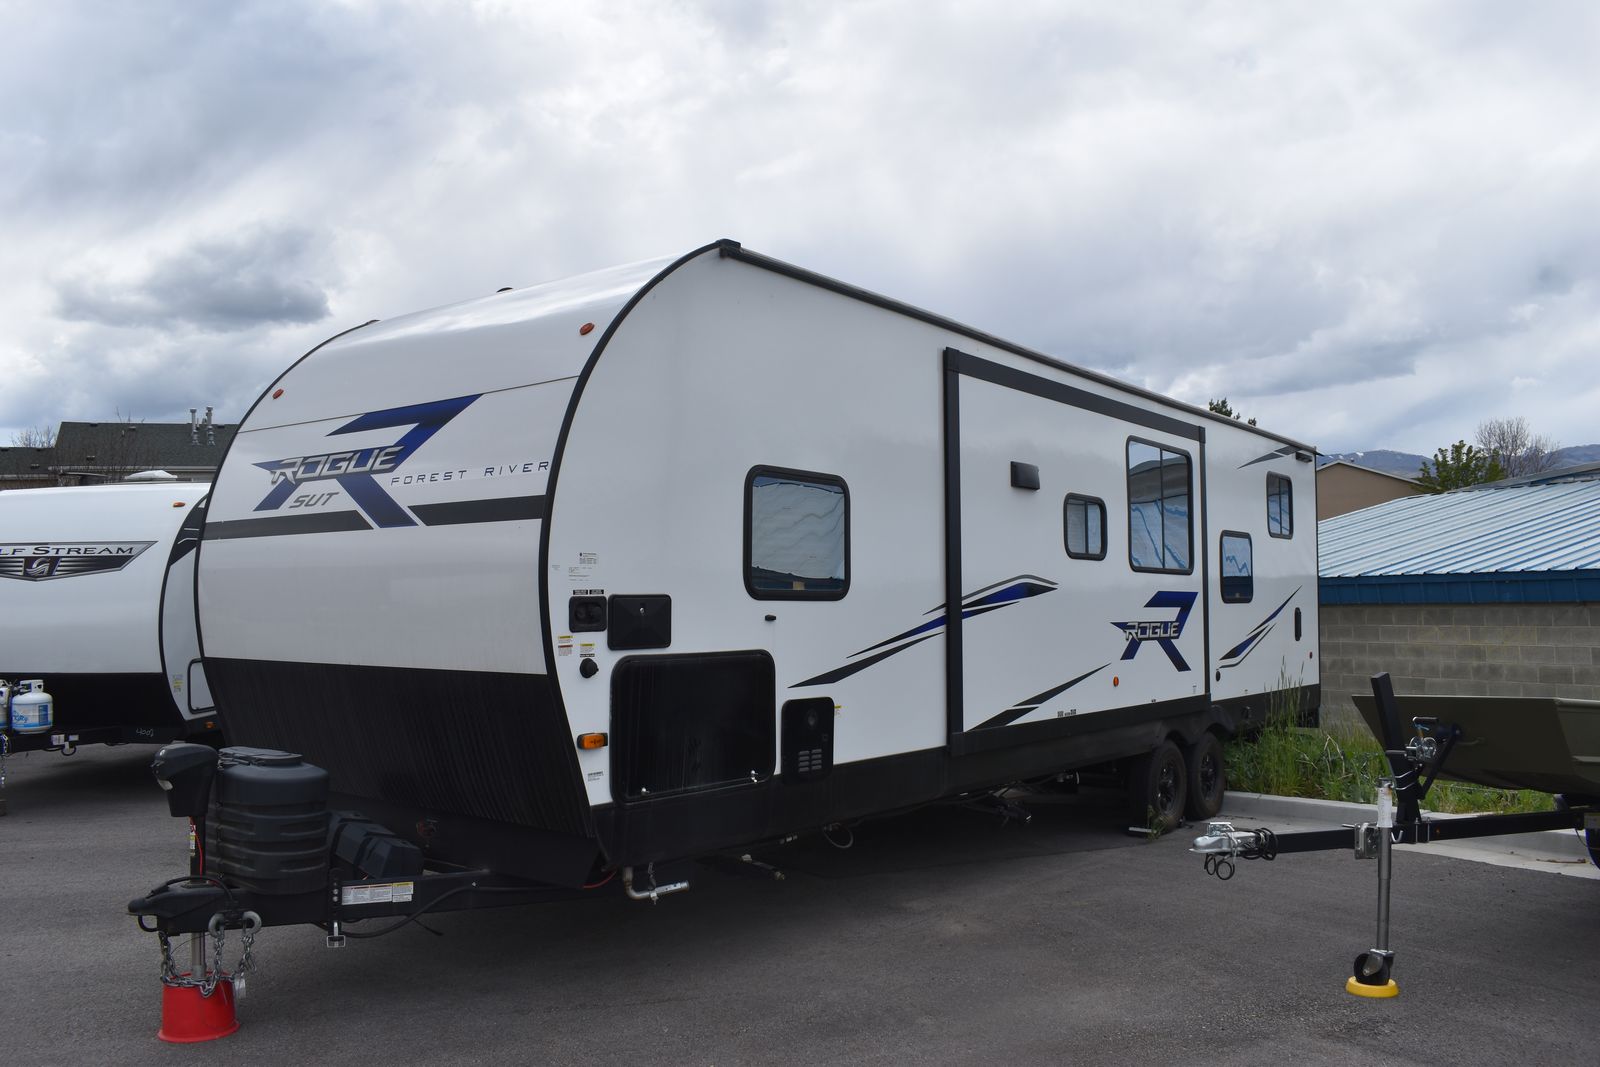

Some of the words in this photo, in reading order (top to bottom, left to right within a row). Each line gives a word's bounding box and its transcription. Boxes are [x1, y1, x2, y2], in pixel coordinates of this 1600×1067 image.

[270, 445, 405, 485] ROGUE
[391, 469, 467, 486] FOREST
[484, 461, 549, 477] RIVER
[288, 492, 340, 509] SUT
[32, 546, 133, 556] STREAM
[1124, 621, 1180, 641] ROGUE
